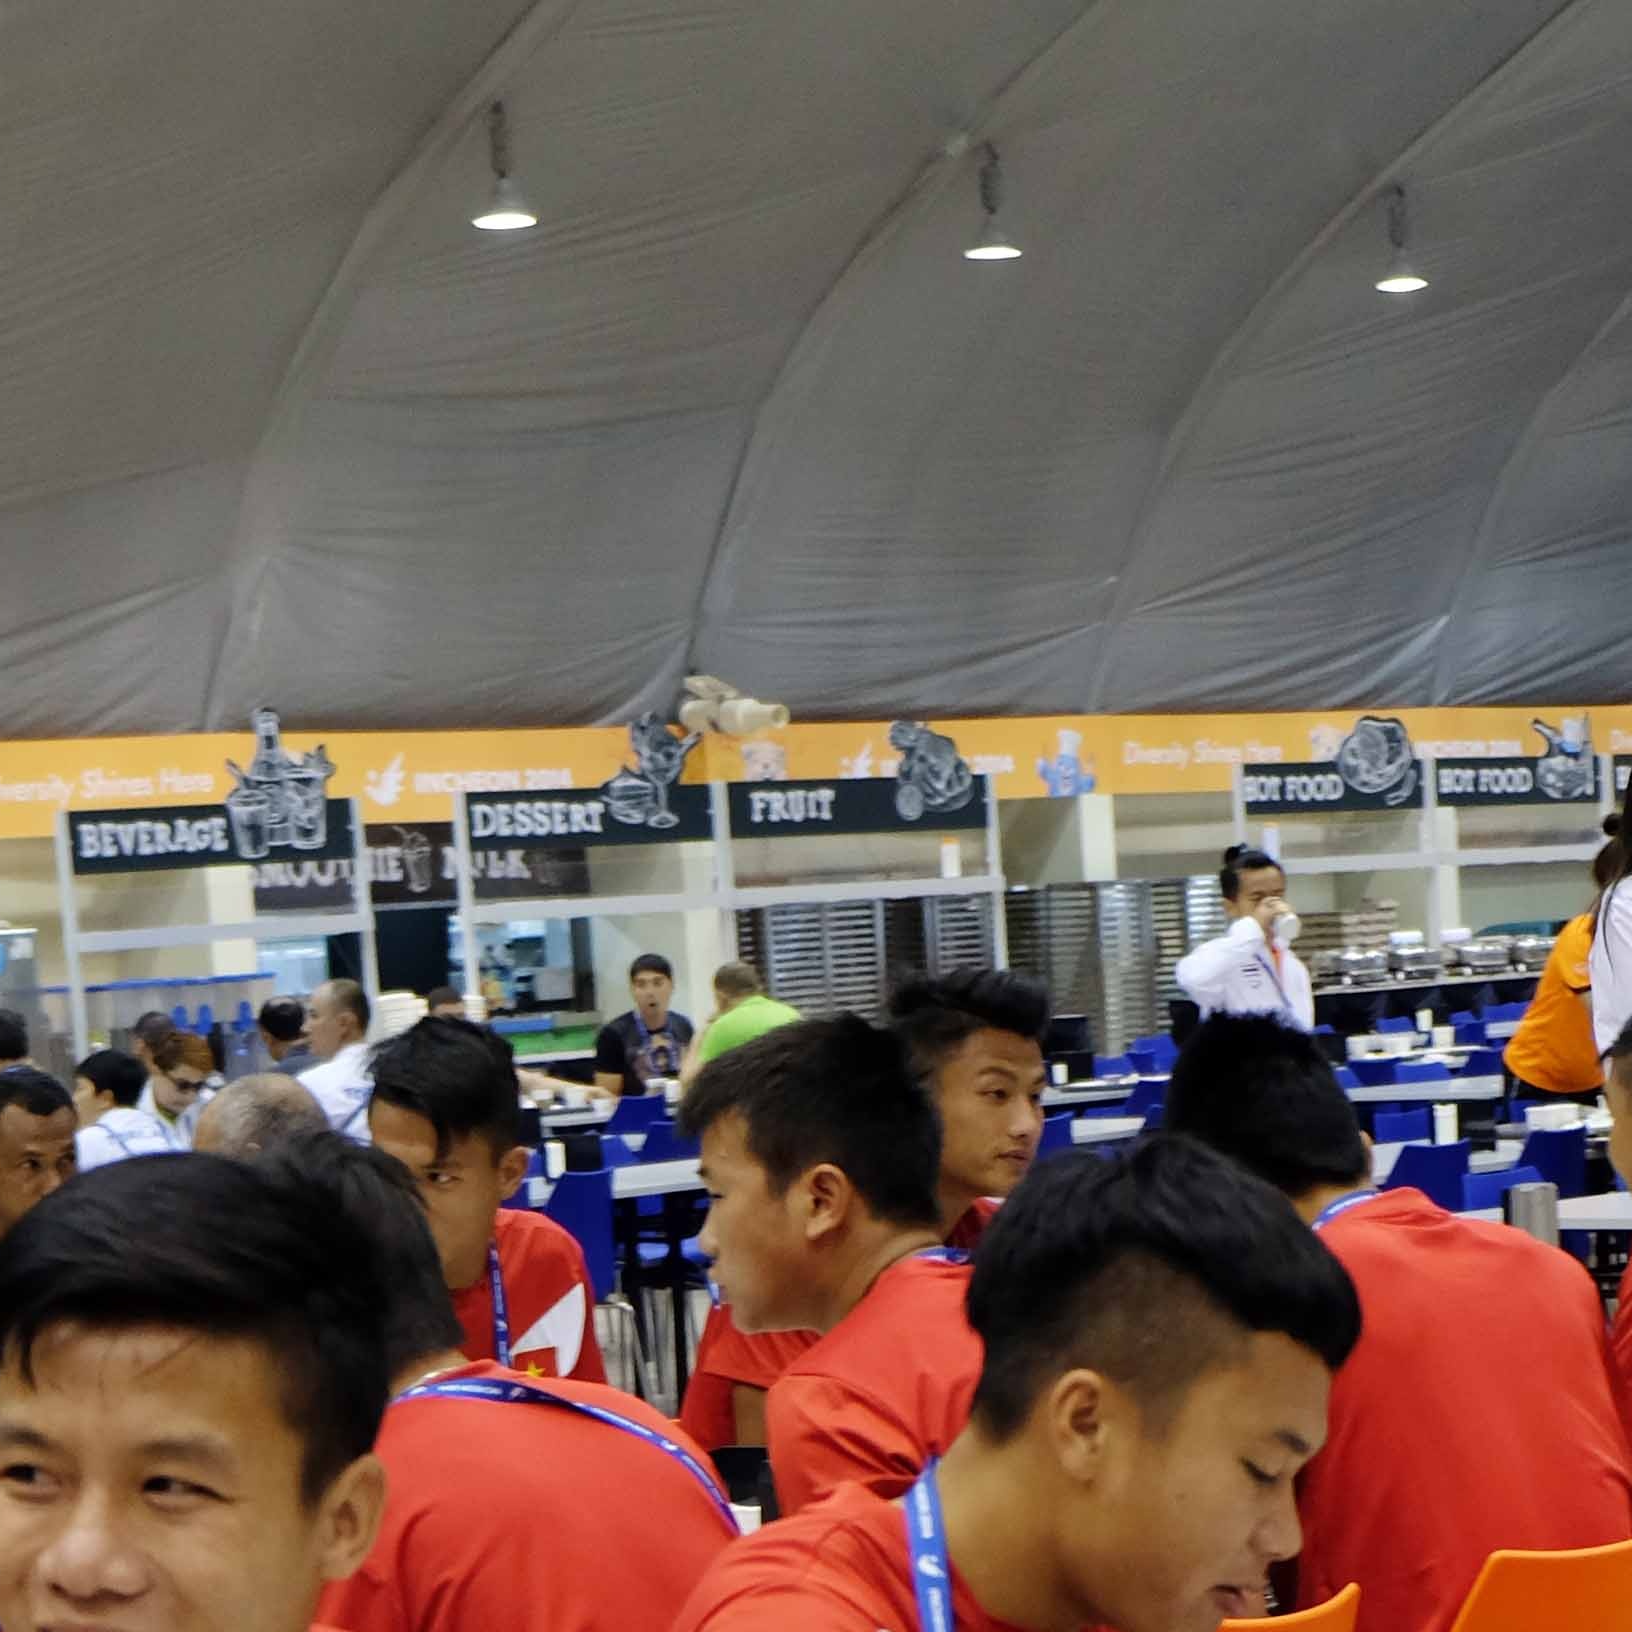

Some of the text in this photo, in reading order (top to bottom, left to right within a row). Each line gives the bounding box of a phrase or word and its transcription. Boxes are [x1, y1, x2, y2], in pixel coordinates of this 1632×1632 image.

[1284, 774, 1345, 801] FOOD
[1478, 767, 1533, 793] FOOD
[470, 801, 607, 838] DESSERT
[749, 788, 835, 823] FRUIT
[77, 817, 229, 858] BEVERAGE
